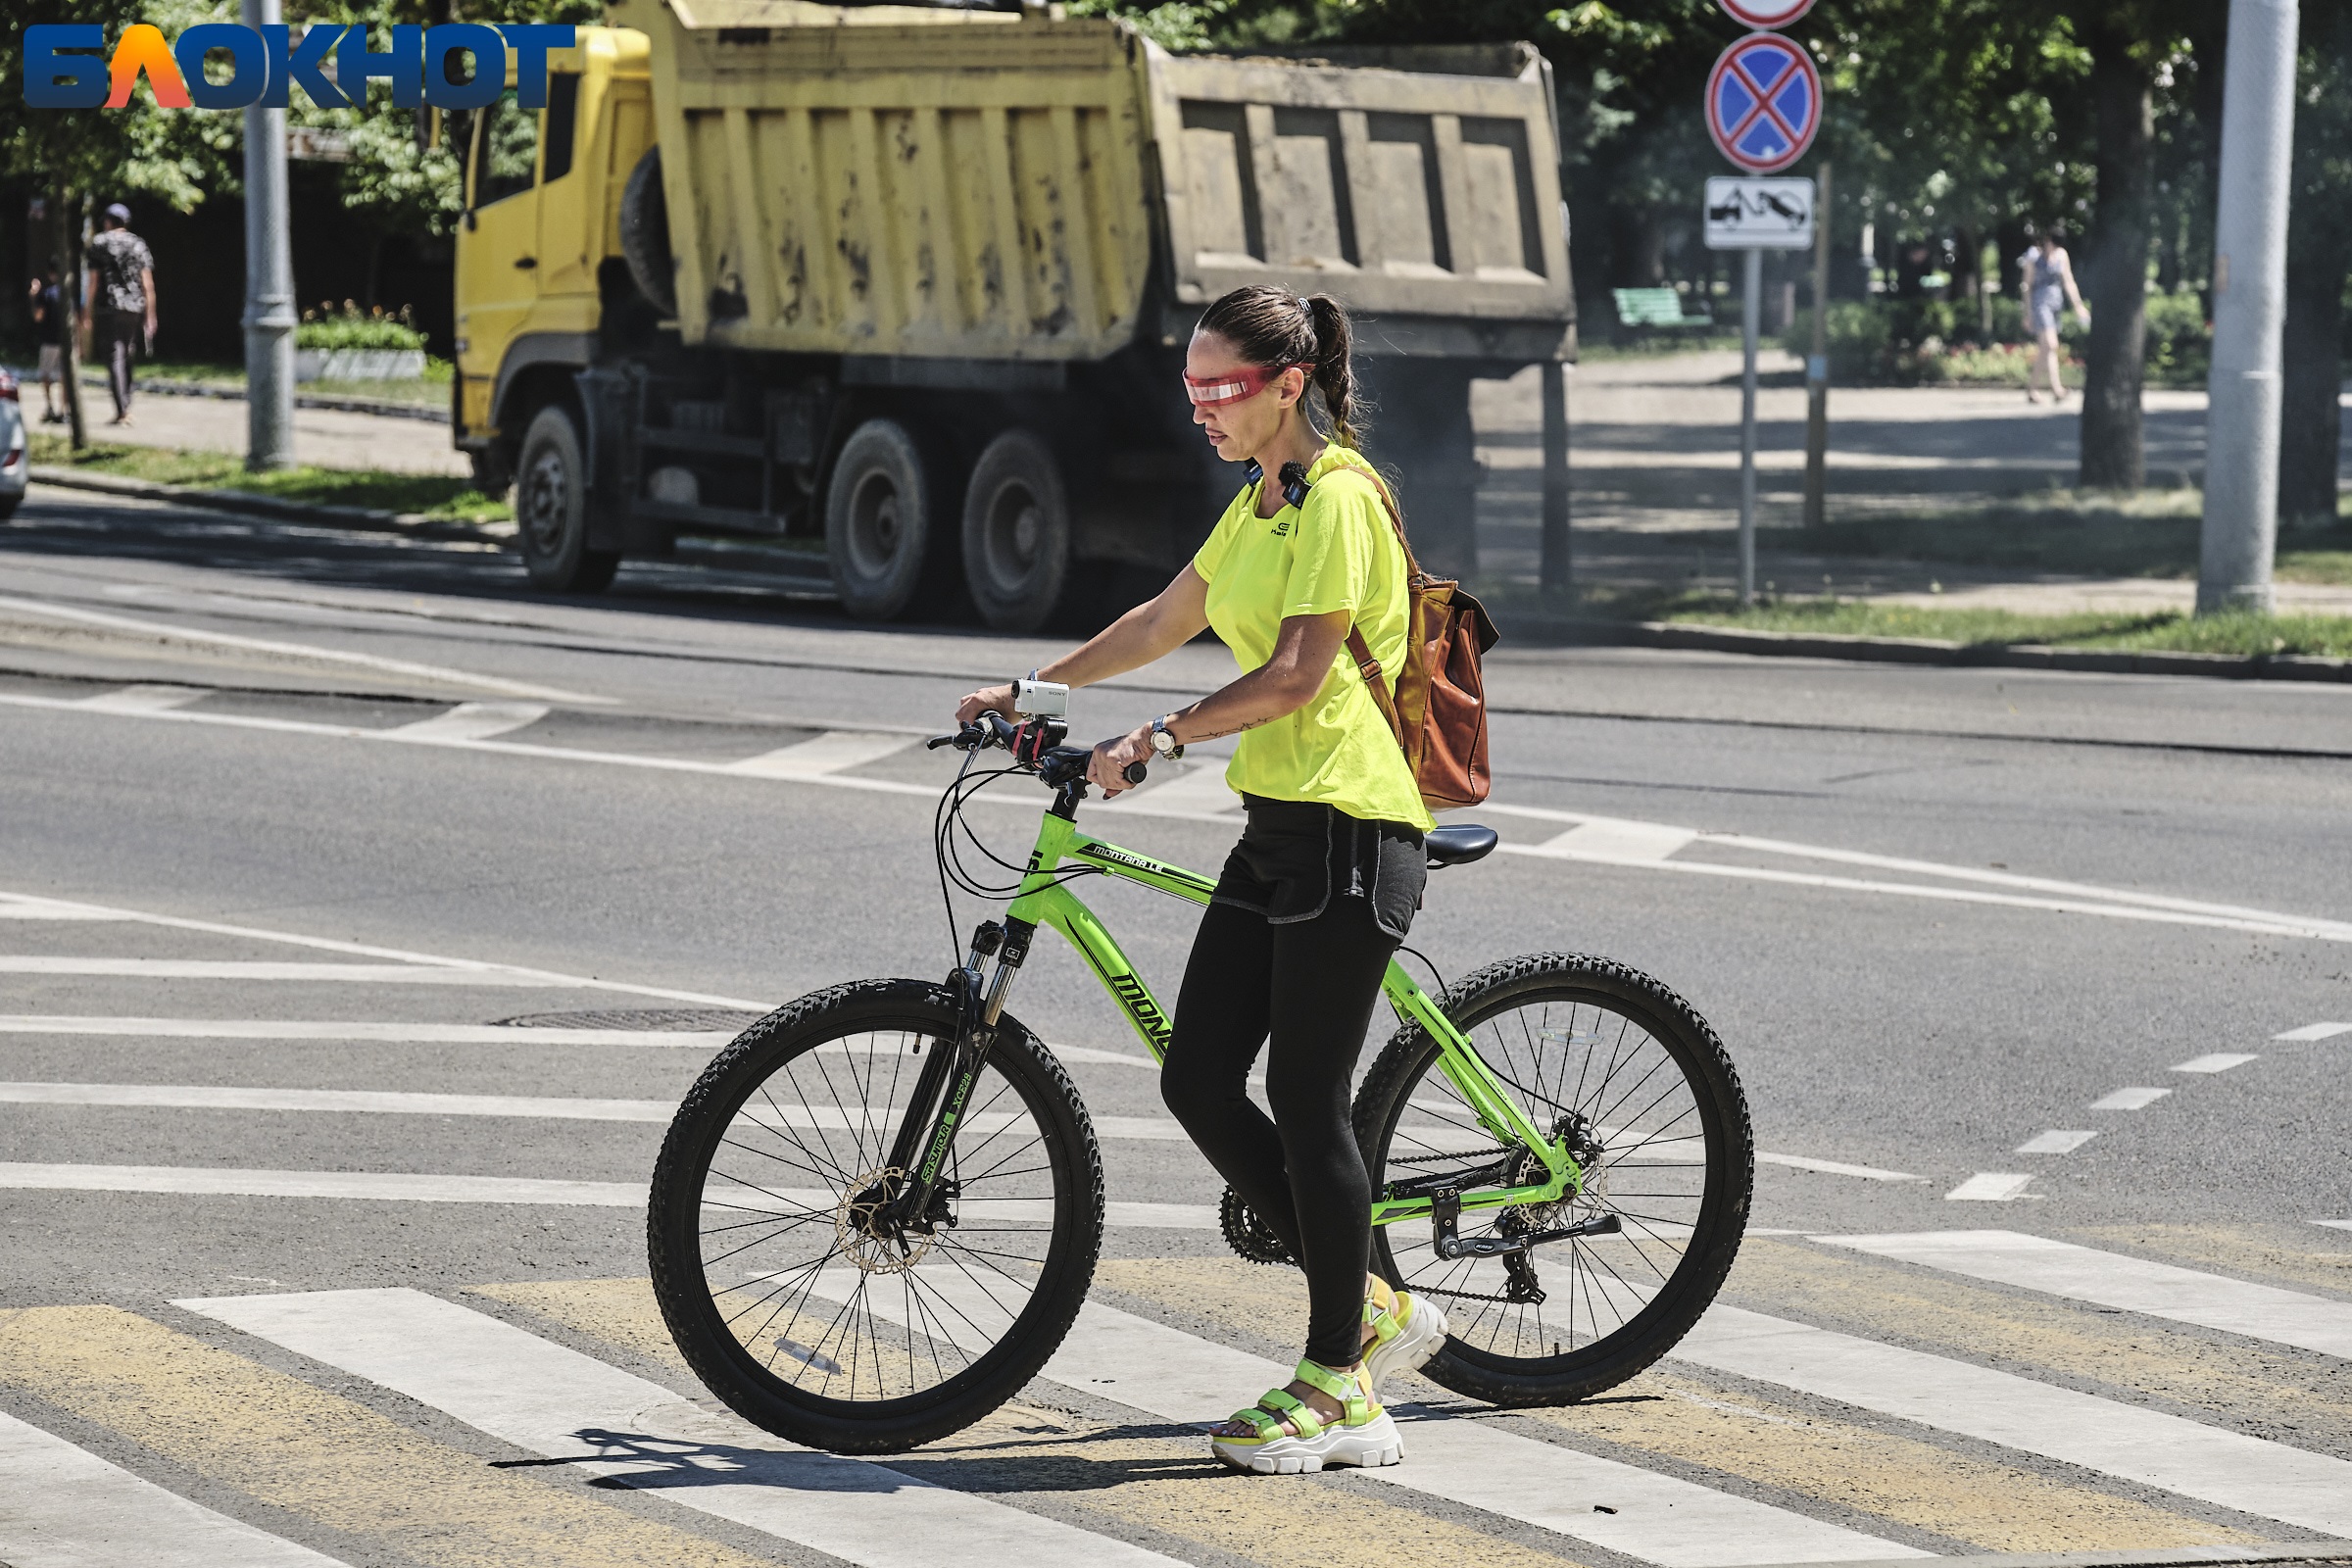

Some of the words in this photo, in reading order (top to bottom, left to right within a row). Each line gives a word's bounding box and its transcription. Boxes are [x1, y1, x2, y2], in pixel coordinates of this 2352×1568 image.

[952, 1072, 972, 1109] XCE28
[928, 1124, 951, 1164] SUNTOUR
[922, 1162, 935, 1182] SR
